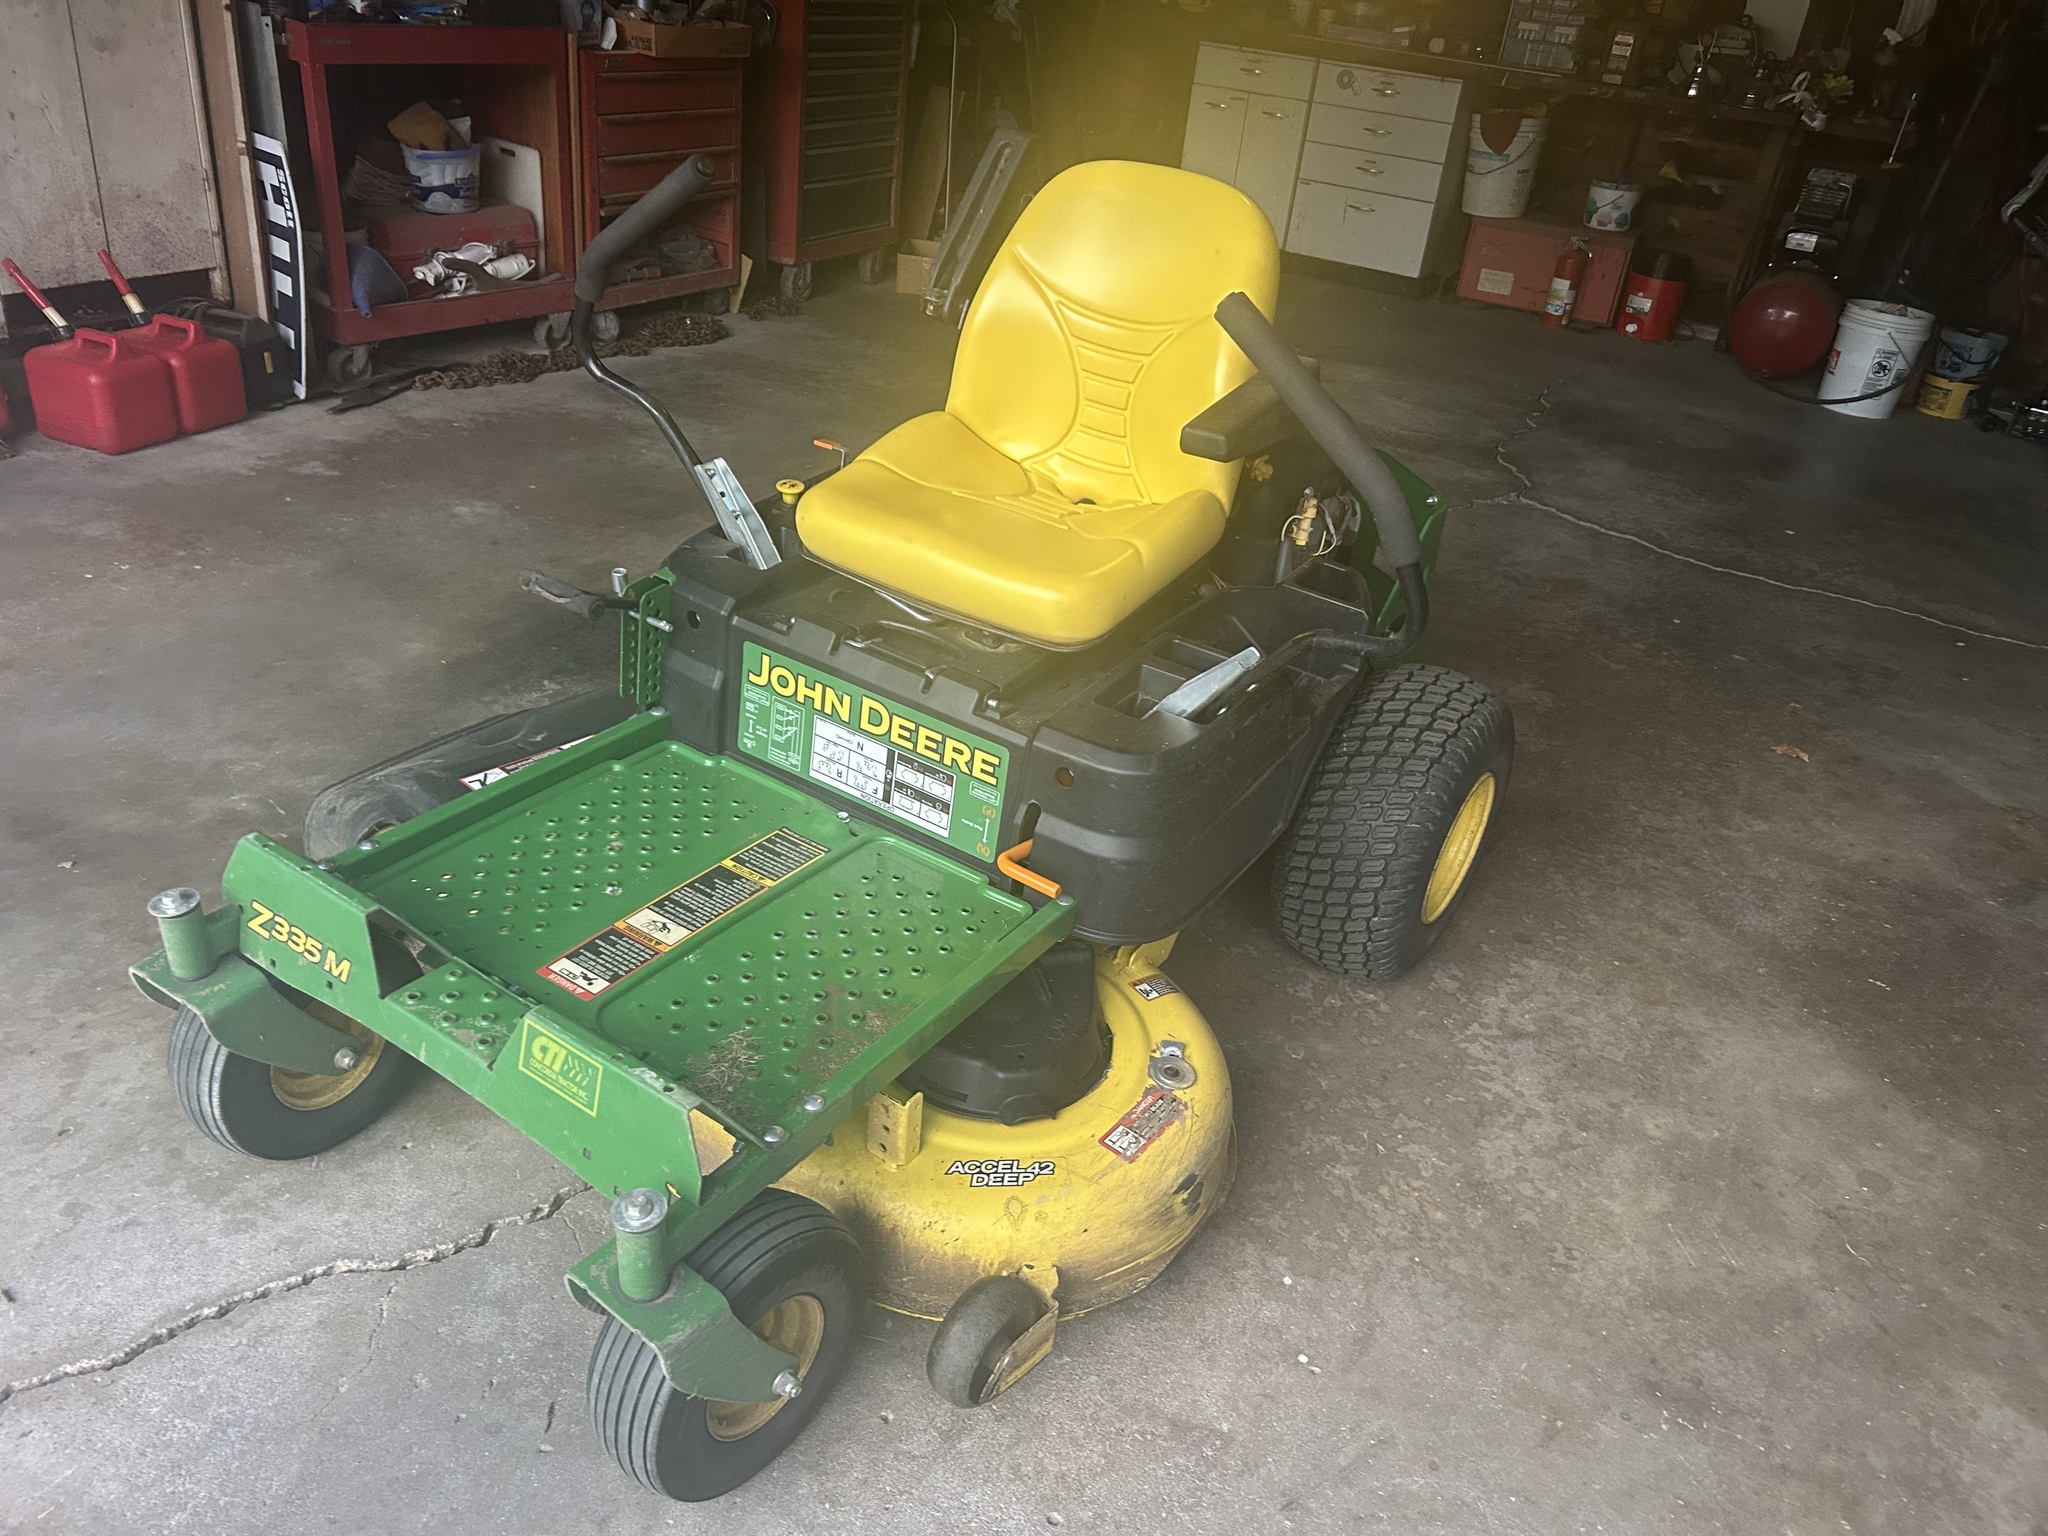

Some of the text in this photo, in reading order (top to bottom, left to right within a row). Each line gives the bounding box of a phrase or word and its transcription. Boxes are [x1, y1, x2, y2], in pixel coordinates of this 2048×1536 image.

[276, 167, 294, 228] Scott
[747, 652, 1001, 785] JOHN DEERE
[856, 740, 864, 751] N
[835, 767, 843, 779] R
[871, 786, 878, 796] F
[860, 792, 895, 813] OPERATION
[730, 863, 759, 878] CAUTION
[622, 925, 655, 943] WARNING
[547, 972, 578, 991] DANGER
[969, 1173, 1037, 1188] DEEP
